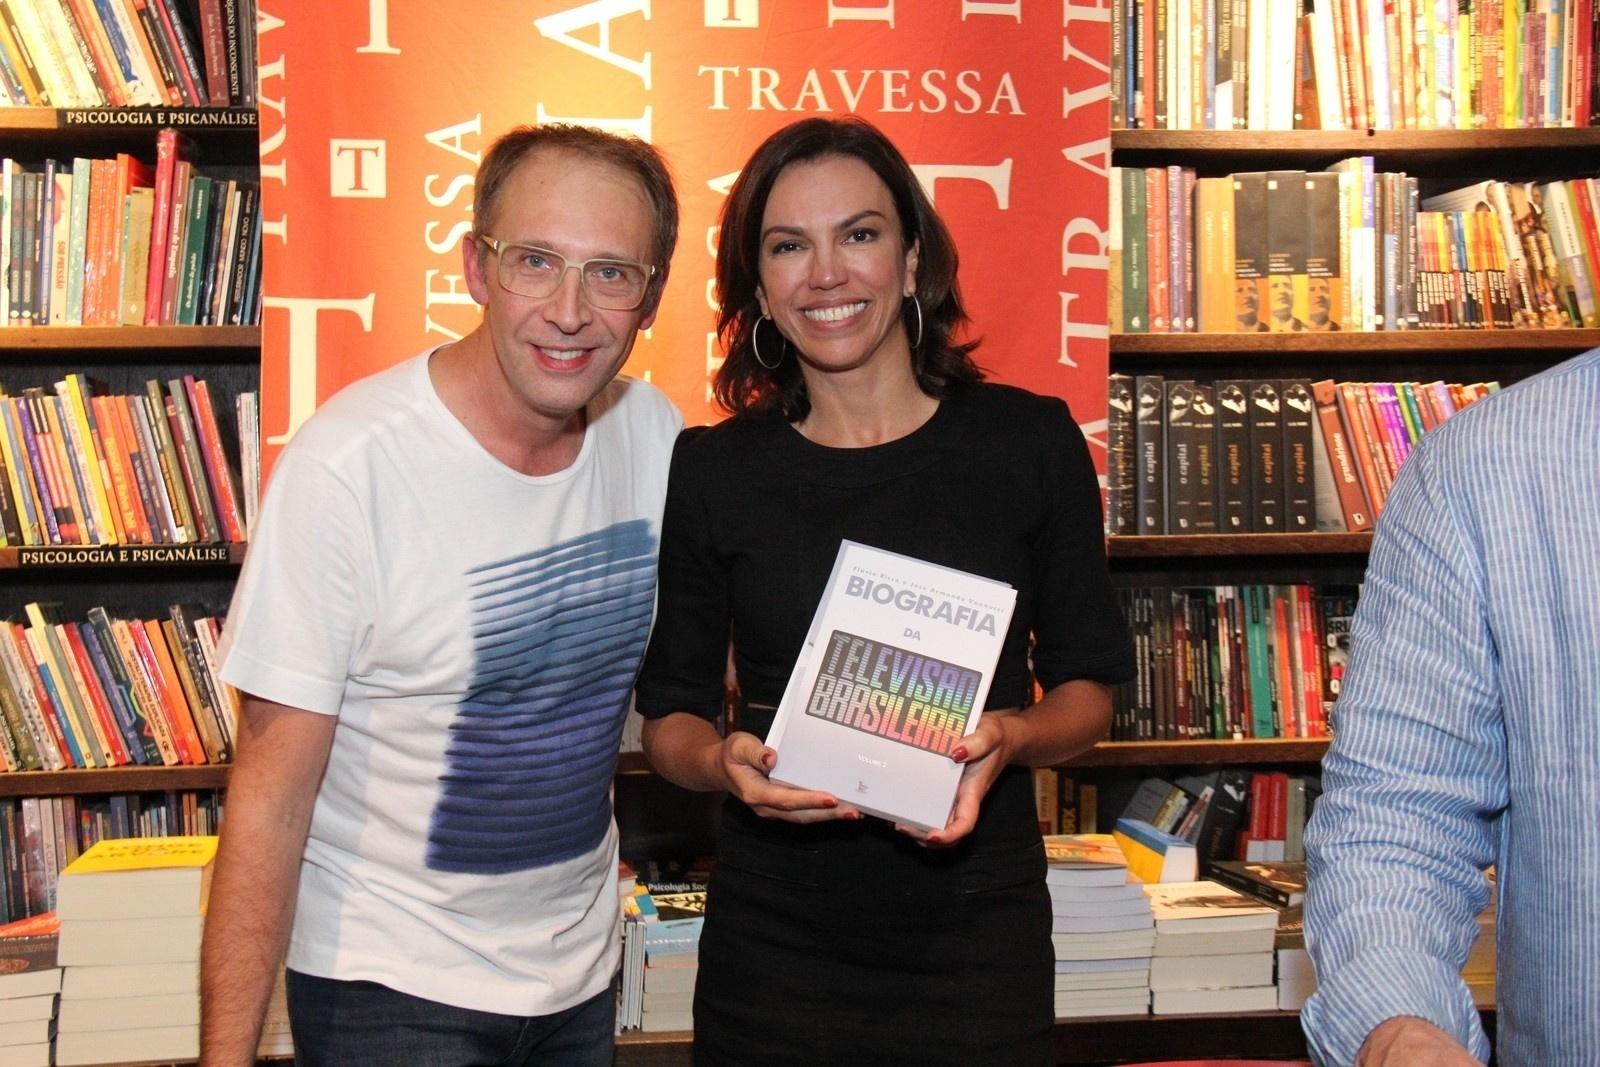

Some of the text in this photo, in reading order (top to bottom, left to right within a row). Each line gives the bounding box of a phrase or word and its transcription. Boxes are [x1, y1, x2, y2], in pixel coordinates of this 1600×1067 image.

[1113, 22, 1121, 56] CULTURAL
[228, 39, 240, 97] INCONSCIENTE
[697, 65, 1027, 116] TRAVESSA
[66, 111, 257, 124] PSICOLOGIA E PSICANÁLISE
[337, 146, 379, 191] T
[241, 217, 250, 237] NOVO
[238, 240, 247, 261] MUNDO
[1145, 442, 1156, 474] capital
[1177, 443, 1188, 476] capital
[1199, 445, 1210, 477] capital
[1228, 444, 1240, 485] o capital
[1262, 443, 1274, 484] o capital
[1294, 443, 1306, 484] o capital
[22, 546, 227, 564] PSICOLOGIA E PSICANÁLISE
[845, 575, 996, 637] BIOGRAFIA
[903, 627, 921, 640] DA
[808, 673, 966, 755] BRASILEIRA
[648, 882, 708, 893] Psicologia Soc
